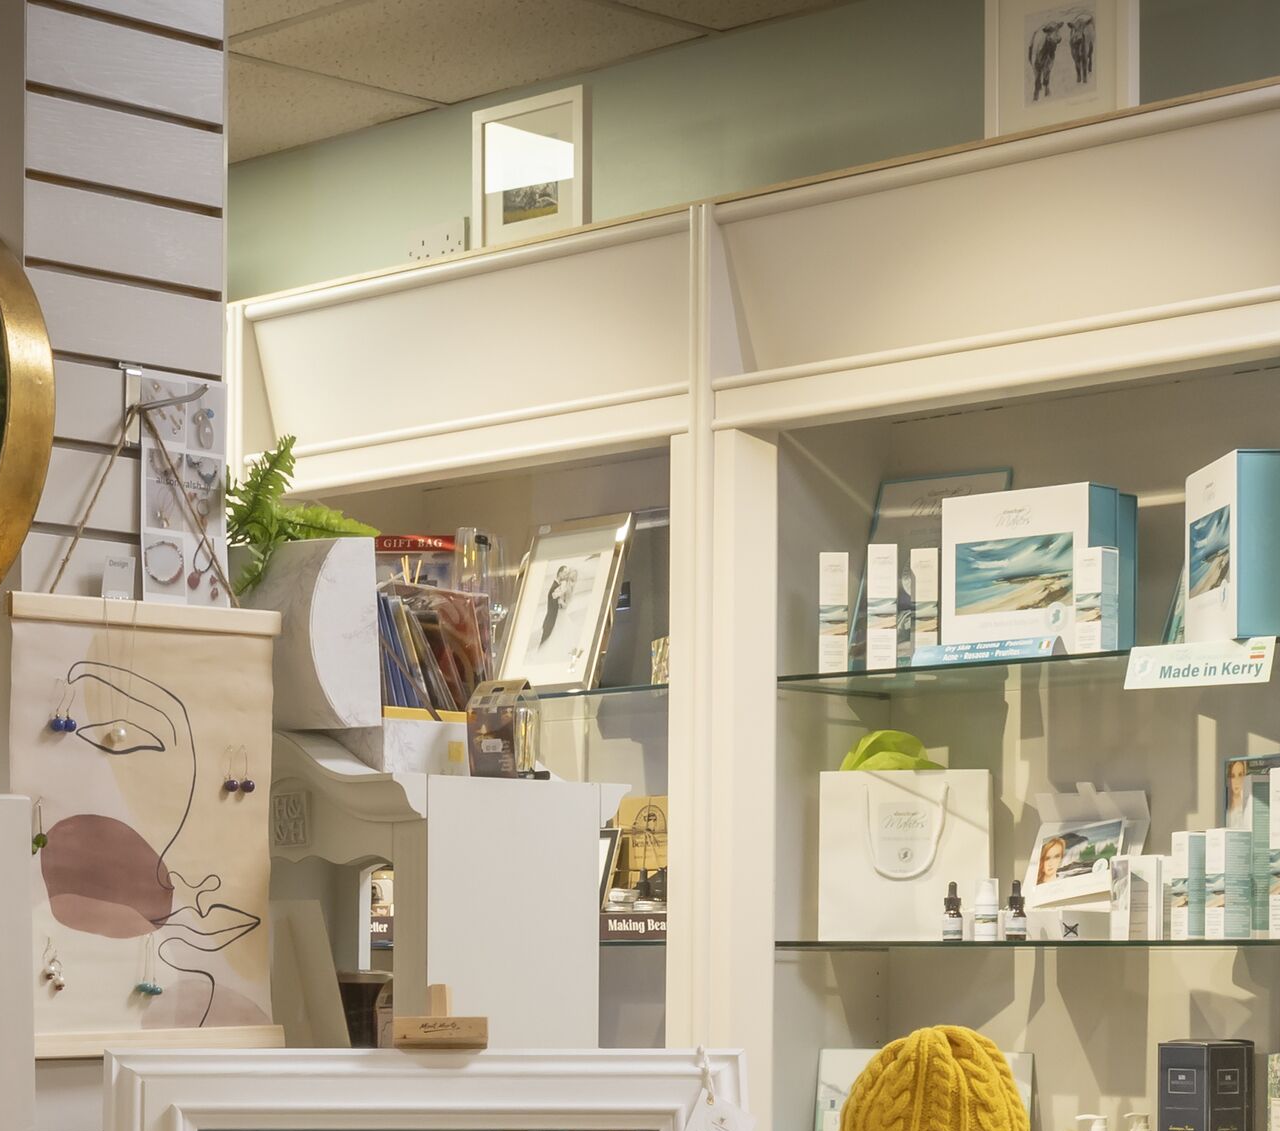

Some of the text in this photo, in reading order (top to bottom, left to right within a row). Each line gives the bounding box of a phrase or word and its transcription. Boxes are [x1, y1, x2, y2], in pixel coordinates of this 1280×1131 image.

[384, 538, 443, 548] GIFT BAG
[1159, 661, 1264, 679] Made in Kerry
[608, 918, 667, 933] Making Bea
